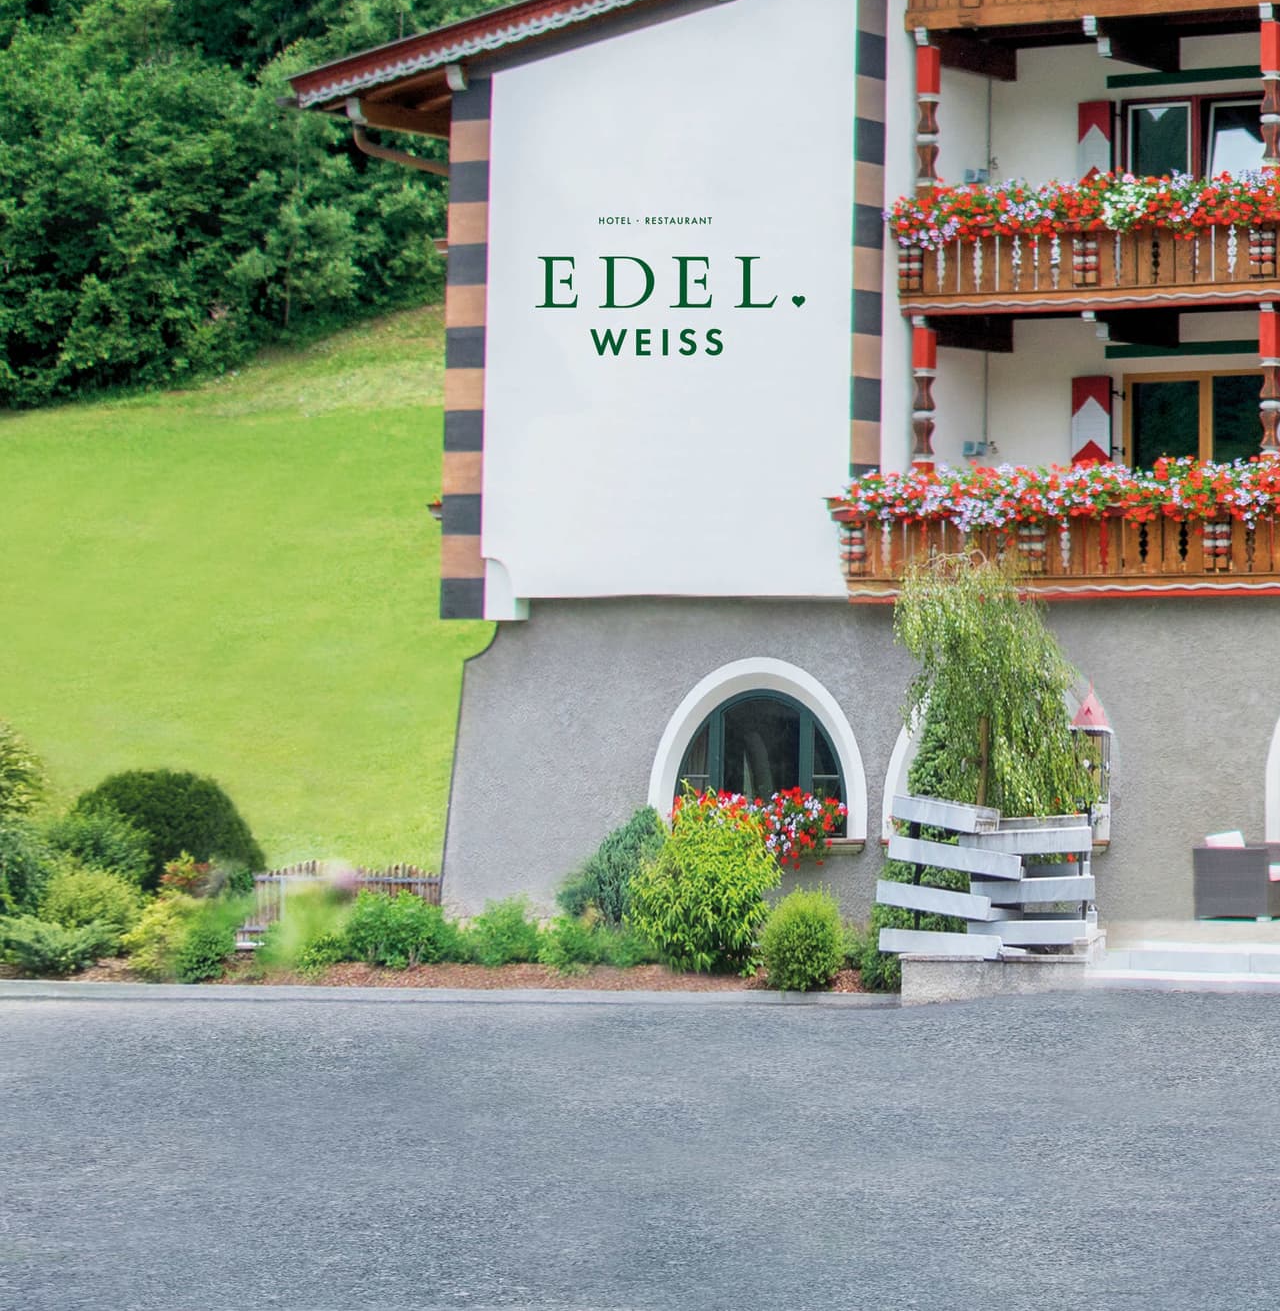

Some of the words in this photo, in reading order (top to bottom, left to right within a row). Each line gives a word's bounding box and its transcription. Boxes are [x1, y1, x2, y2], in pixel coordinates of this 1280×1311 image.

[598, 216, 632, 225] HOTEL
[644, 216, 713, 225] RESTAURANT
[535, 256, 779, 308] EDEL
[590, 328, 724, 356] WEISS
